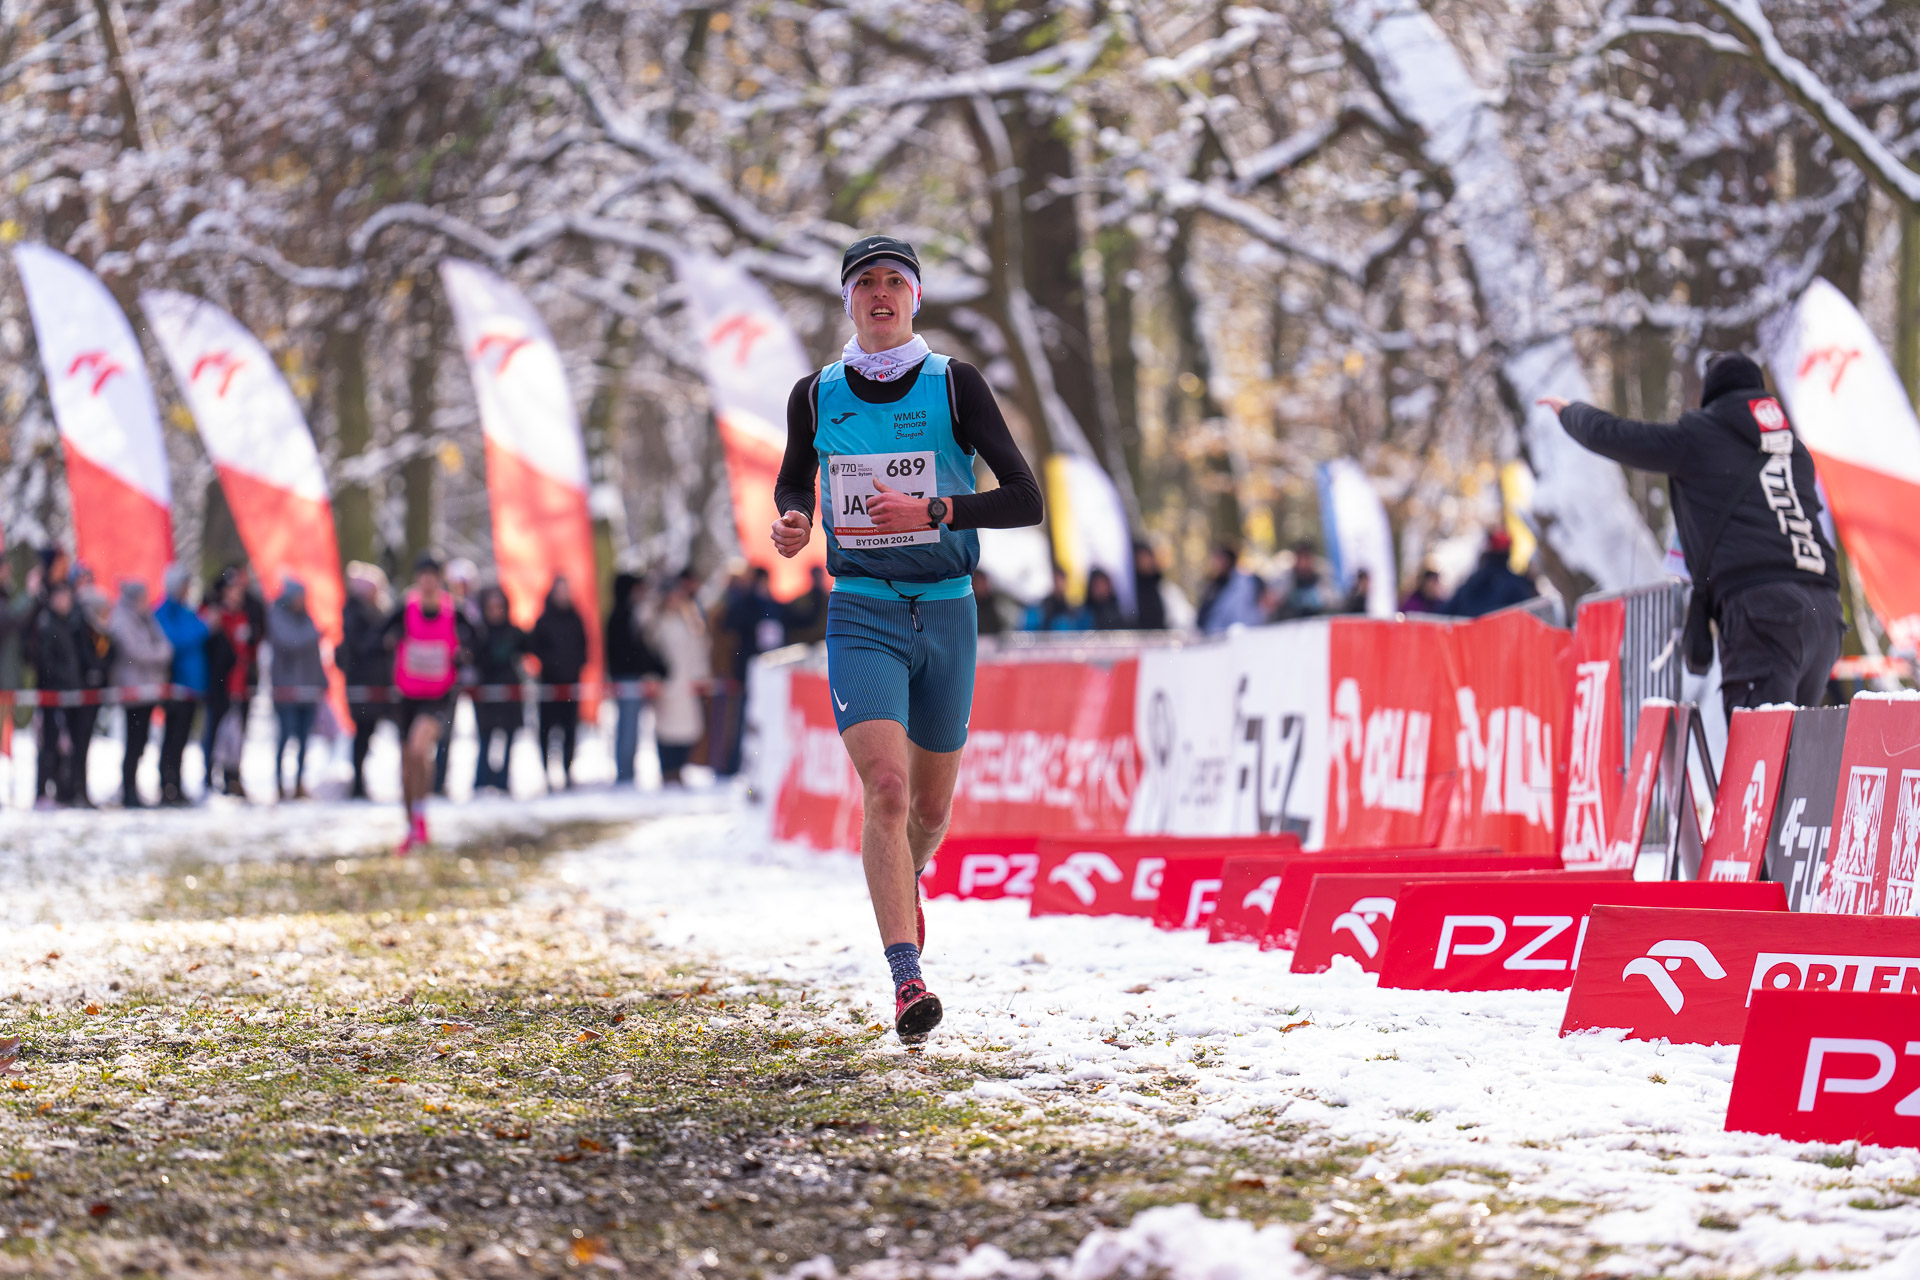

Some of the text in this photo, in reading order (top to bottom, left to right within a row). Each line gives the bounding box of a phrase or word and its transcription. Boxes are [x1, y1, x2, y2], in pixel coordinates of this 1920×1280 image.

[893, 410, 927, 421] WMLKS
[893, 421, 927, 429] Pomorze
[840, 463, 857, 473] 770
[886, 457, 926, 477] 689
[856, 535, 914, 546] BYTOM 2024
